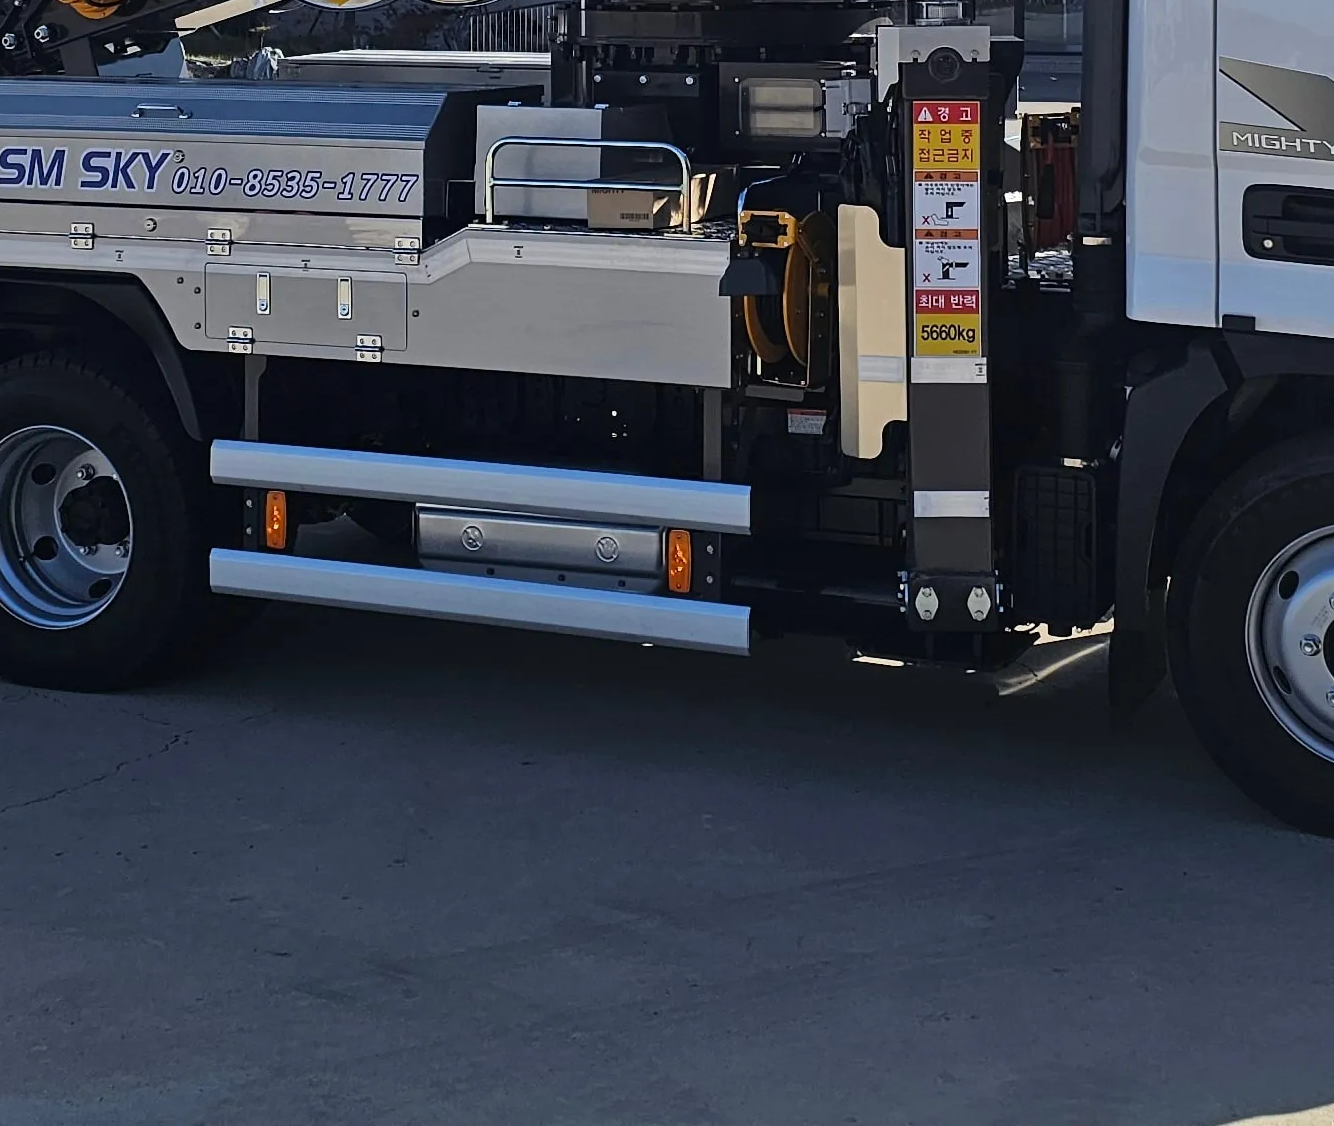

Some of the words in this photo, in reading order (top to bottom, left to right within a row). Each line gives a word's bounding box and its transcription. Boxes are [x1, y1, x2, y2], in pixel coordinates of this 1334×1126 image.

[918, 148, 974, 163] 접근금지
[80, 150, 171, 190] SKY
[171, 166, 419, 202] 010-8535-1777
[918, 294, 945, 309] 최대
[950, 294, 977, 309] 반력
[921, 323, 976, 343] 5660kg
